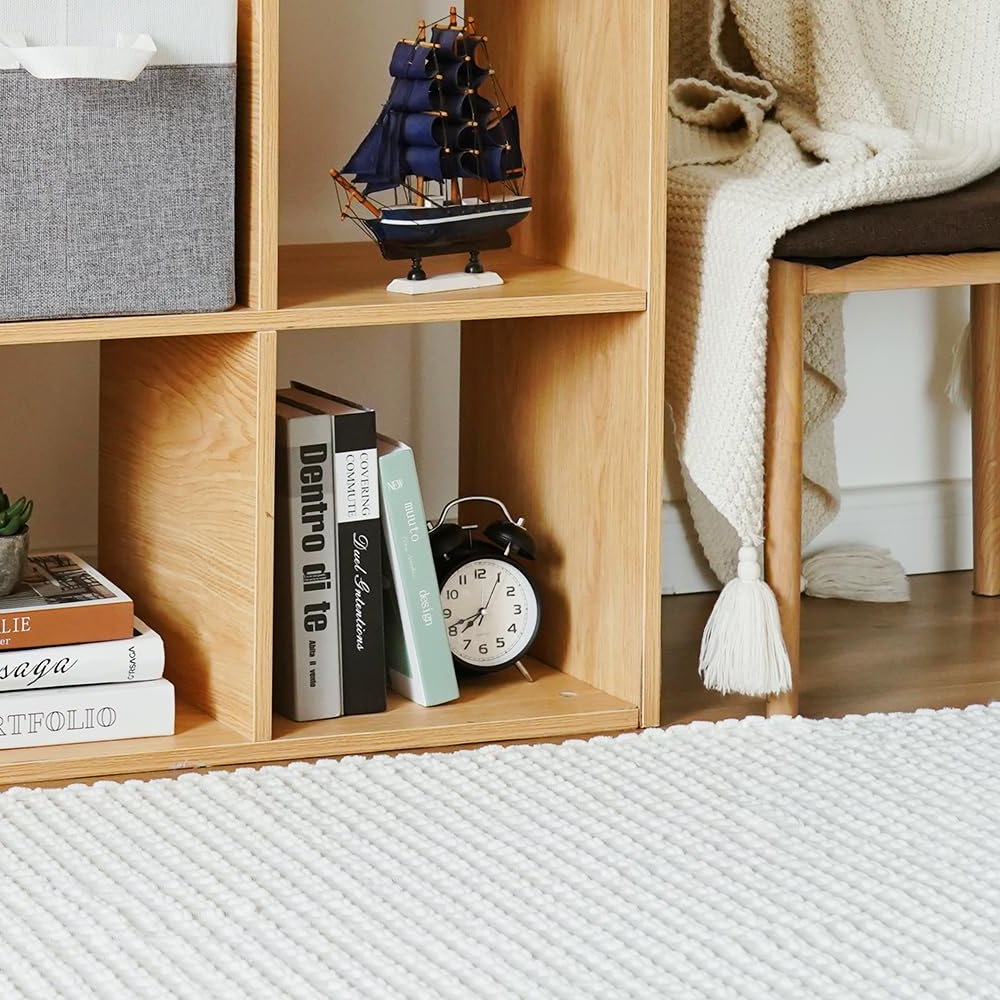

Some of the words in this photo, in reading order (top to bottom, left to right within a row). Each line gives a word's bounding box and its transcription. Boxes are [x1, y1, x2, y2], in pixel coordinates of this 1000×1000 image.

[345, 454, 356, 518] COMMUTE
[359, 452, 371, 516] COVERING
[299, 443, 328, 553] Dentro
[404, 502, 420, 542] muuto
[302, 563, 331, 592] di
[474, 568, 487, 579] 12
[459, 574, 467, 585] 11
[446, 589, 459, 600] 10
[506, 586, 516, 597] 2
[419, 589, 433, 626] design
[513, 604, 522, 615] 3
[304, 601, 331, 632] te
[442, 608, 452, 619] 9
[448, 625, 458, 636] 8
[507, 623, 517, 634] 4
[463, 639, 472, 650] 7
[496, 637, 505, 648] 5
[308, 640, 316, 657] Abita
[478, 643, 488, 655] 6
